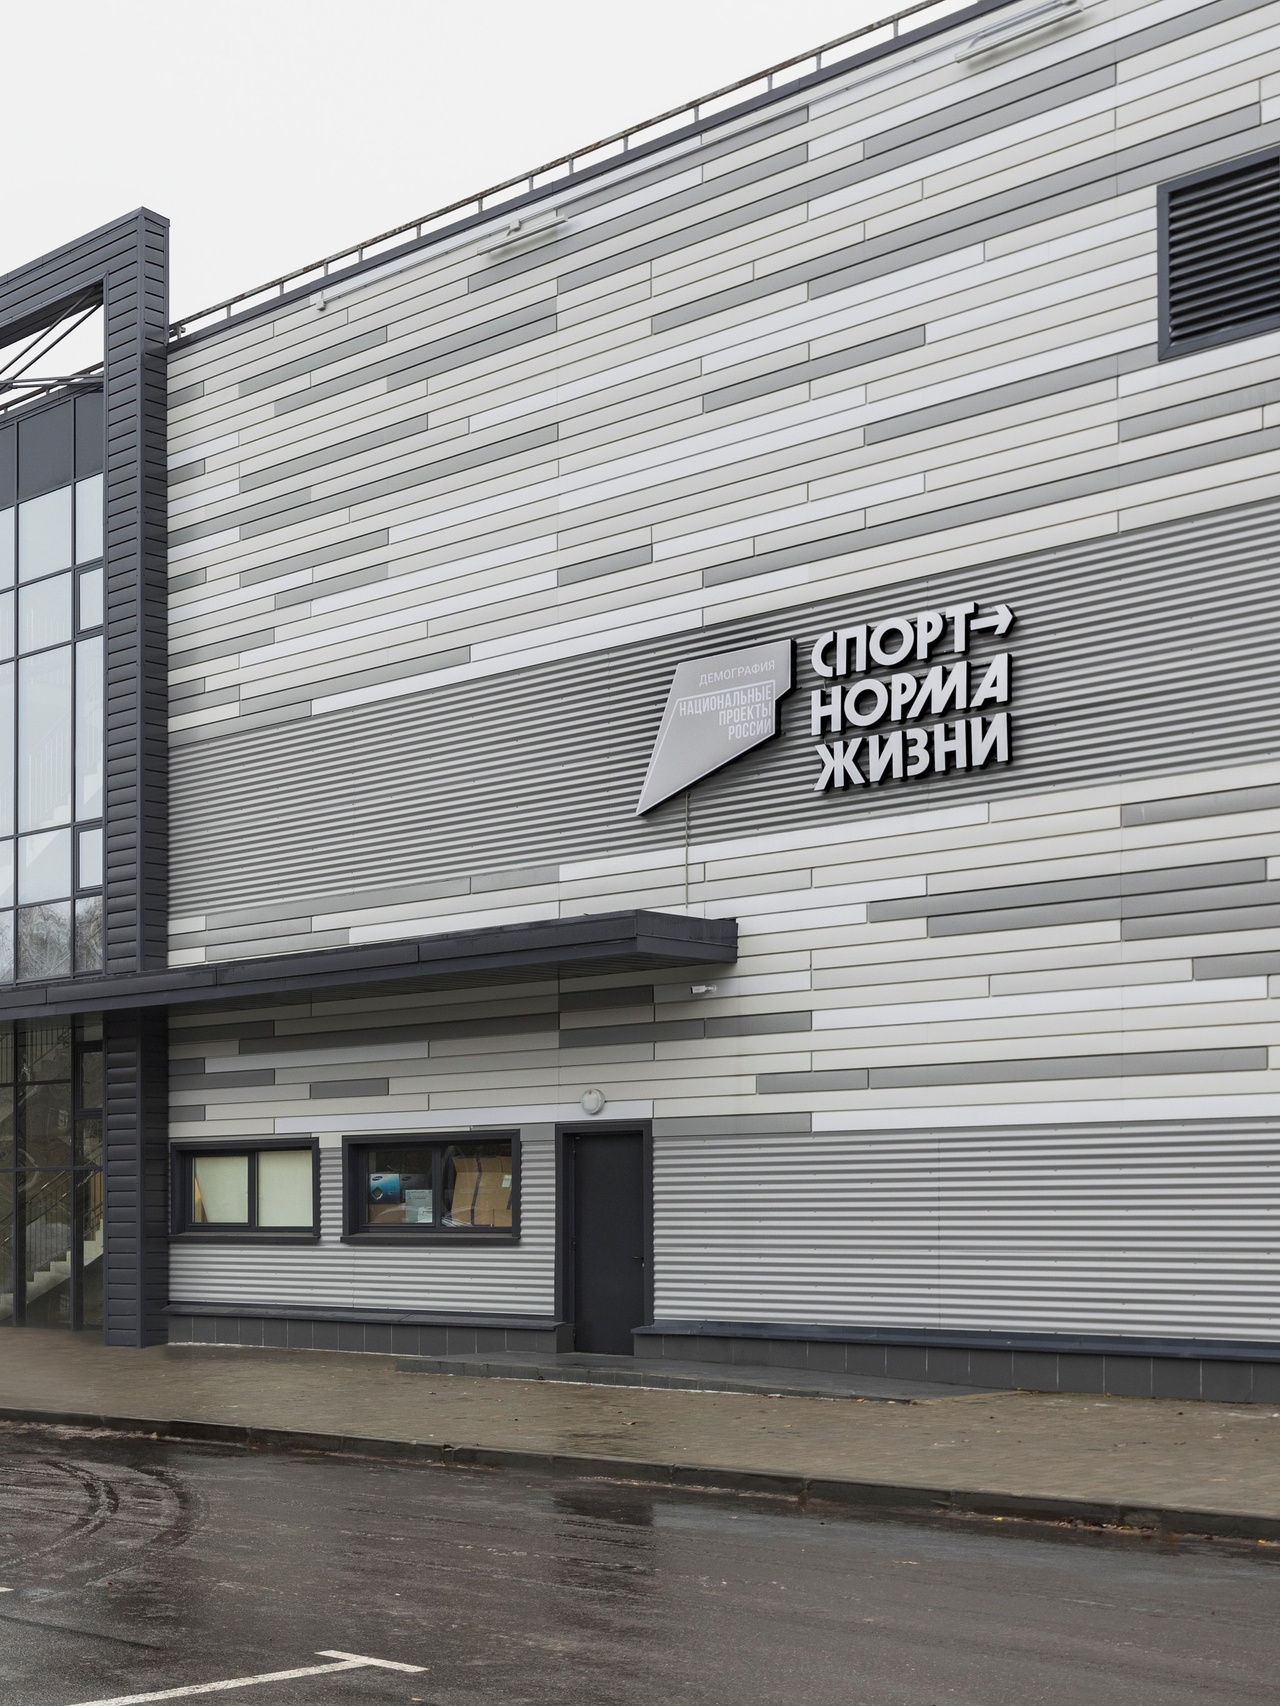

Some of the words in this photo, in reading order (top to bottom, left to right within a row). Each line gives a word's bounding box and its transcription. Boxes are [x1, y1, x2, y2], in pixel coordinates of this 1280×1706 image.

[811, 602, 975, 678] СПОРТ
[699, 660, 775, 687] ДЕМОГРАФИЯ
[679, 684, 772, 717] НАЦИОНАЛЬНЫЕ
[811, 653, 1009, 736] НОРМА
[719, 701, 772, 726] ПРОЕКТЫ
[728, 718, 772, 740] РОССИИ
[814, 712, 1009, 791] ЖИЗНИ
